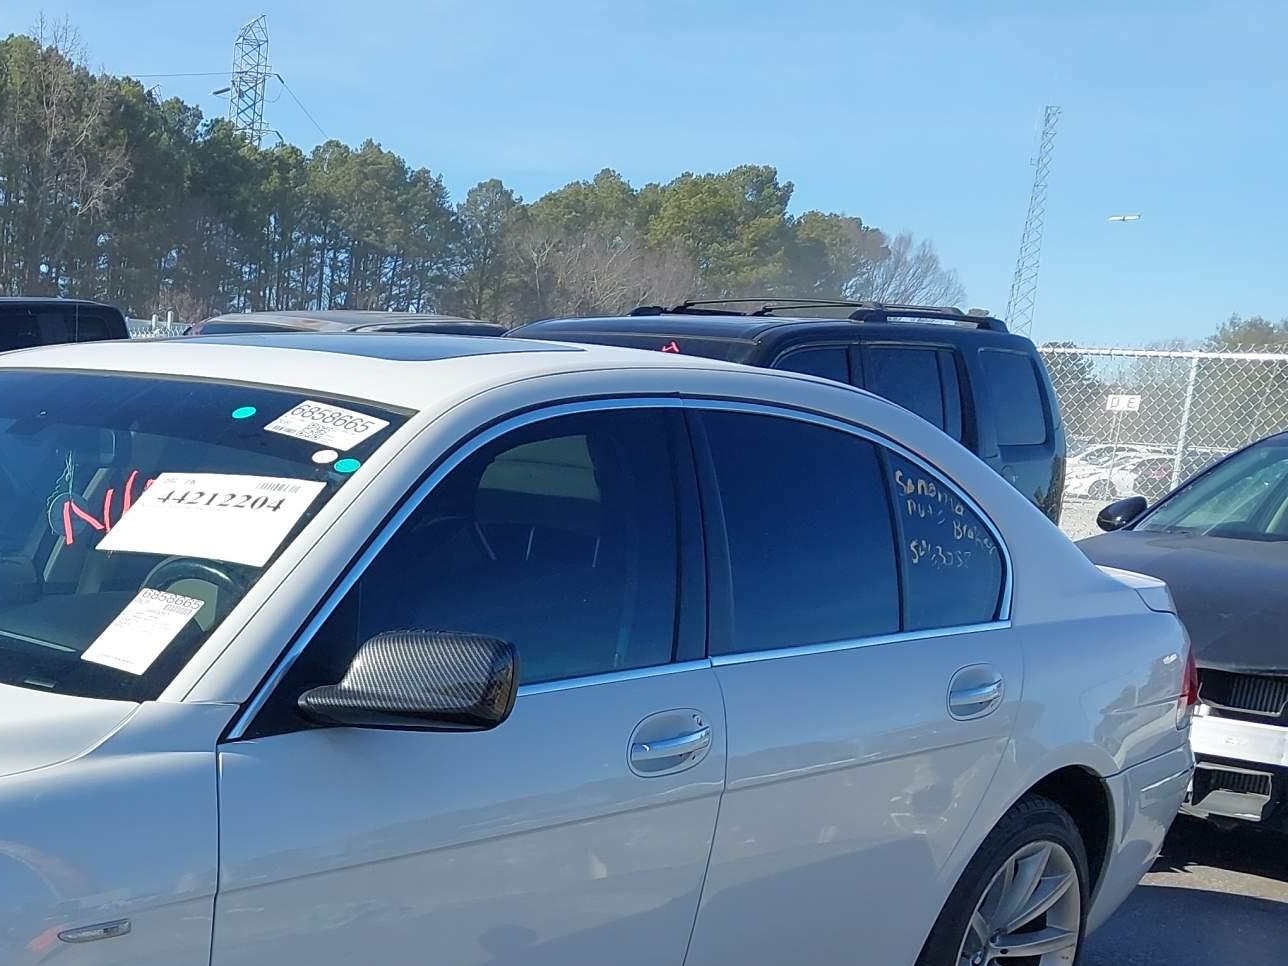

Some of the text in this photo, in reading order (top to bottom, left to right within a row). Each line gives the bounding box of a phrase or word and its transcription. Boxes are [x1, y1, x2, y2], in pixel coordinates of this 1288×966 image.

[291, 404, 375, 433] 6858665
[63, 469, 154, 545] N/
[158, 490, 286, 512] 44212204
